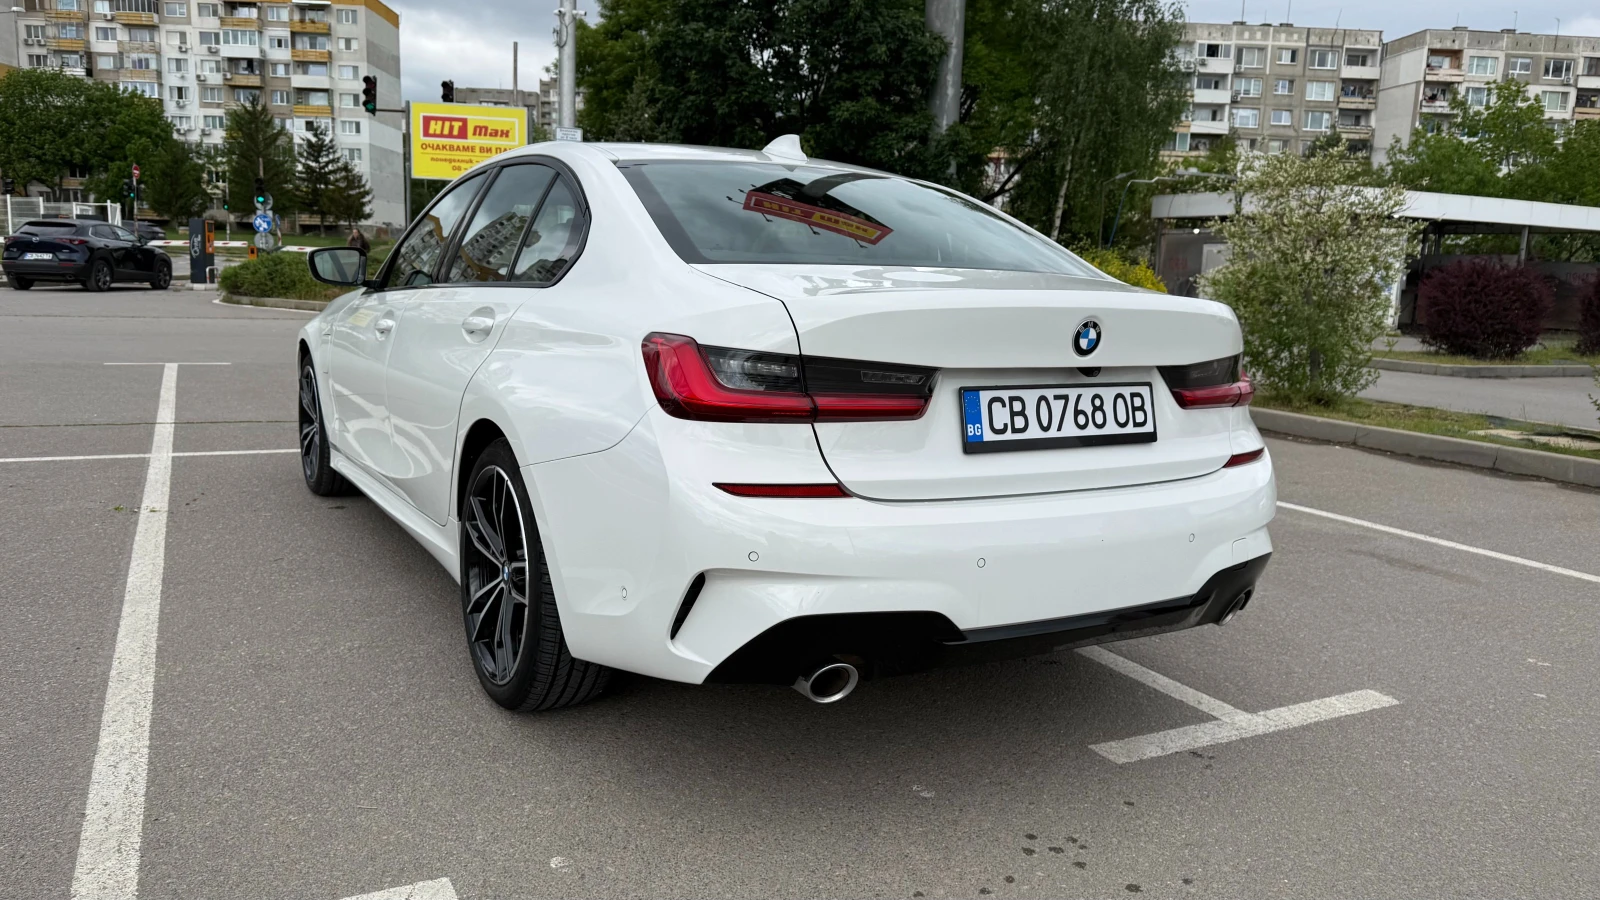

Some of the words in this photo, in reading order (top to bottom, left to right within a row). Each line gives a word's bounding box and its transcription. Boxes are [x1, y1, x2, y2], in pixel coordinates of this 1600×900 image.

[428, 120, 463, 136] HIT
[421, 143, 477, 154] ОЧАКВАМЕ
[479, 146, 493, 154] ВИ
[987, 396, 1029, 435] CB
[1035, 393, 1107, 432] 0768
[1112, 392, 1148, 428] OB
[967, 424, 982, 436] BG
